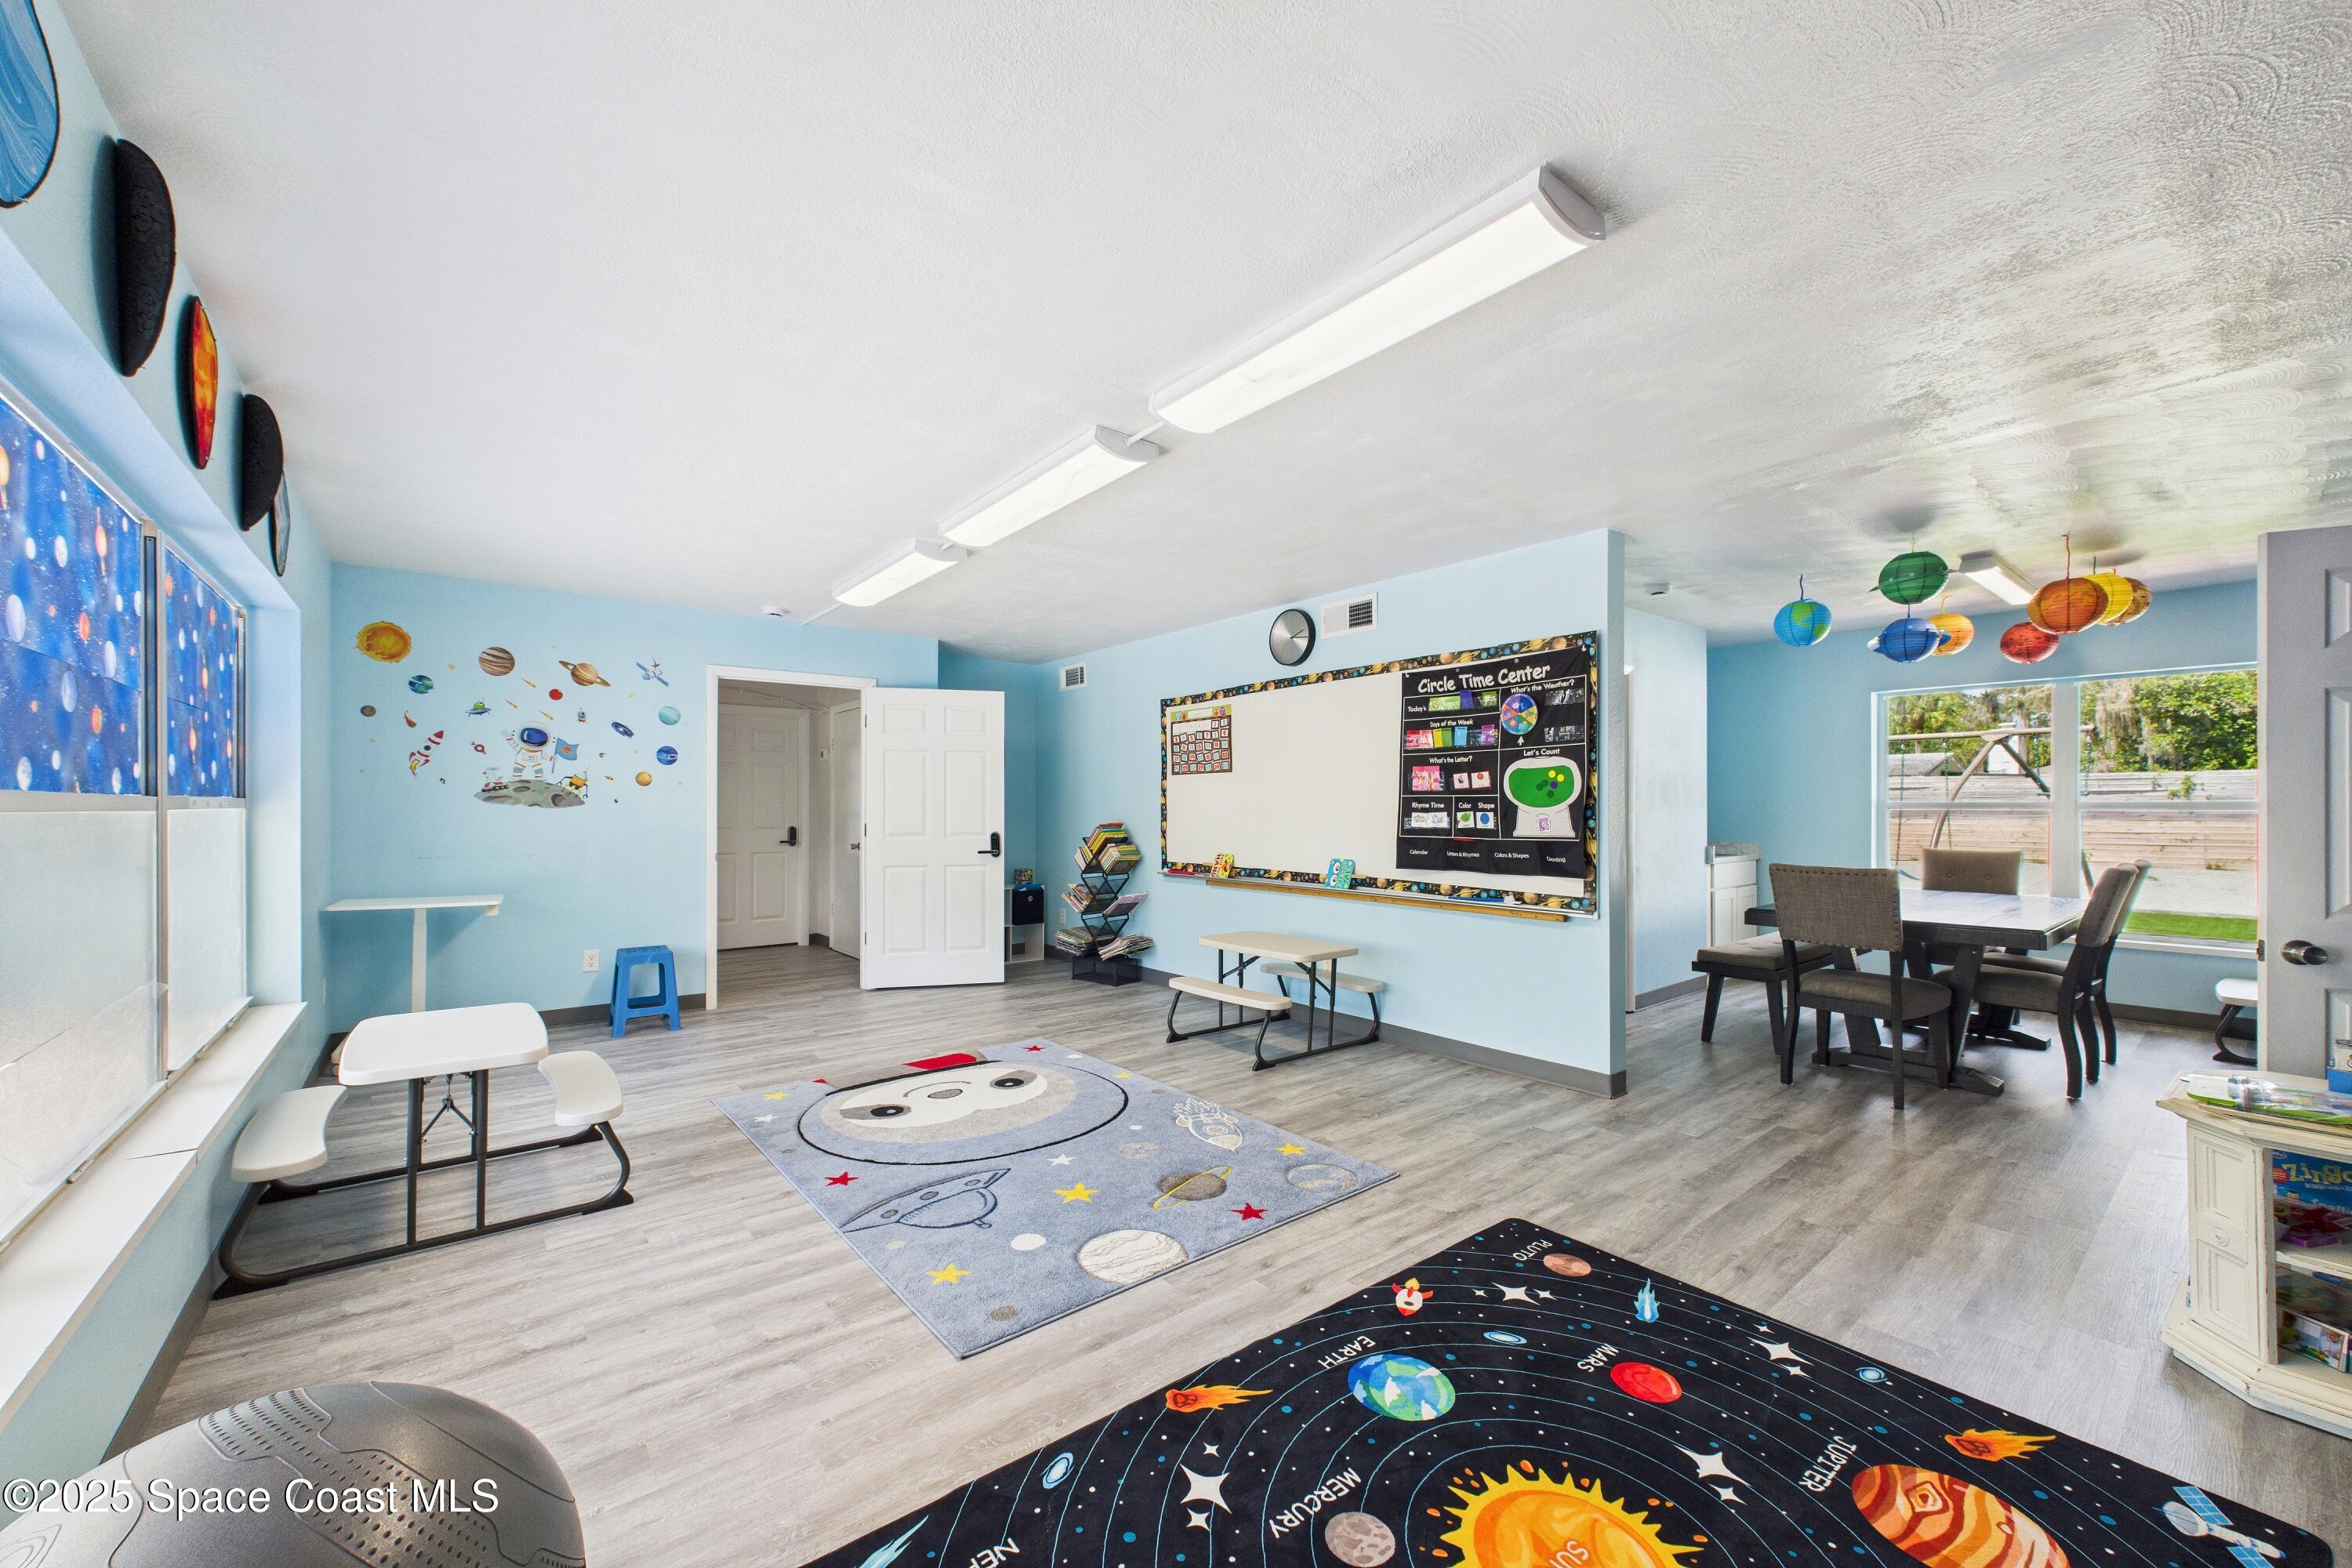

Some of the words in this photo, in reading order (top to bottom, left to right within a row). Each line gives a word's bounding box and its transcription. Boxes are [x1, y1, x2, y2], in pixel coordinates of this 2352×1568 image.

[1417, 676, 1456, 693] Circle
[1458, 673, 1495, 689] Time
[1497, 665, 1551, 684] Center
[1511, 685, 1530, 694] What's
[1543, 679, 1575, 690] Weather?
[1211, 854, 1221, 877] HAND
[1512, 1239, 1553, 1261] PLUTO
[1317, 1335, 1376, 1370] EARTH
[1577, 1343, 1620, 1372] MARS
[1798, 1436, 1857, 1492] JUPITER
[1269, 1468, 1362, 1538] MERCURY
